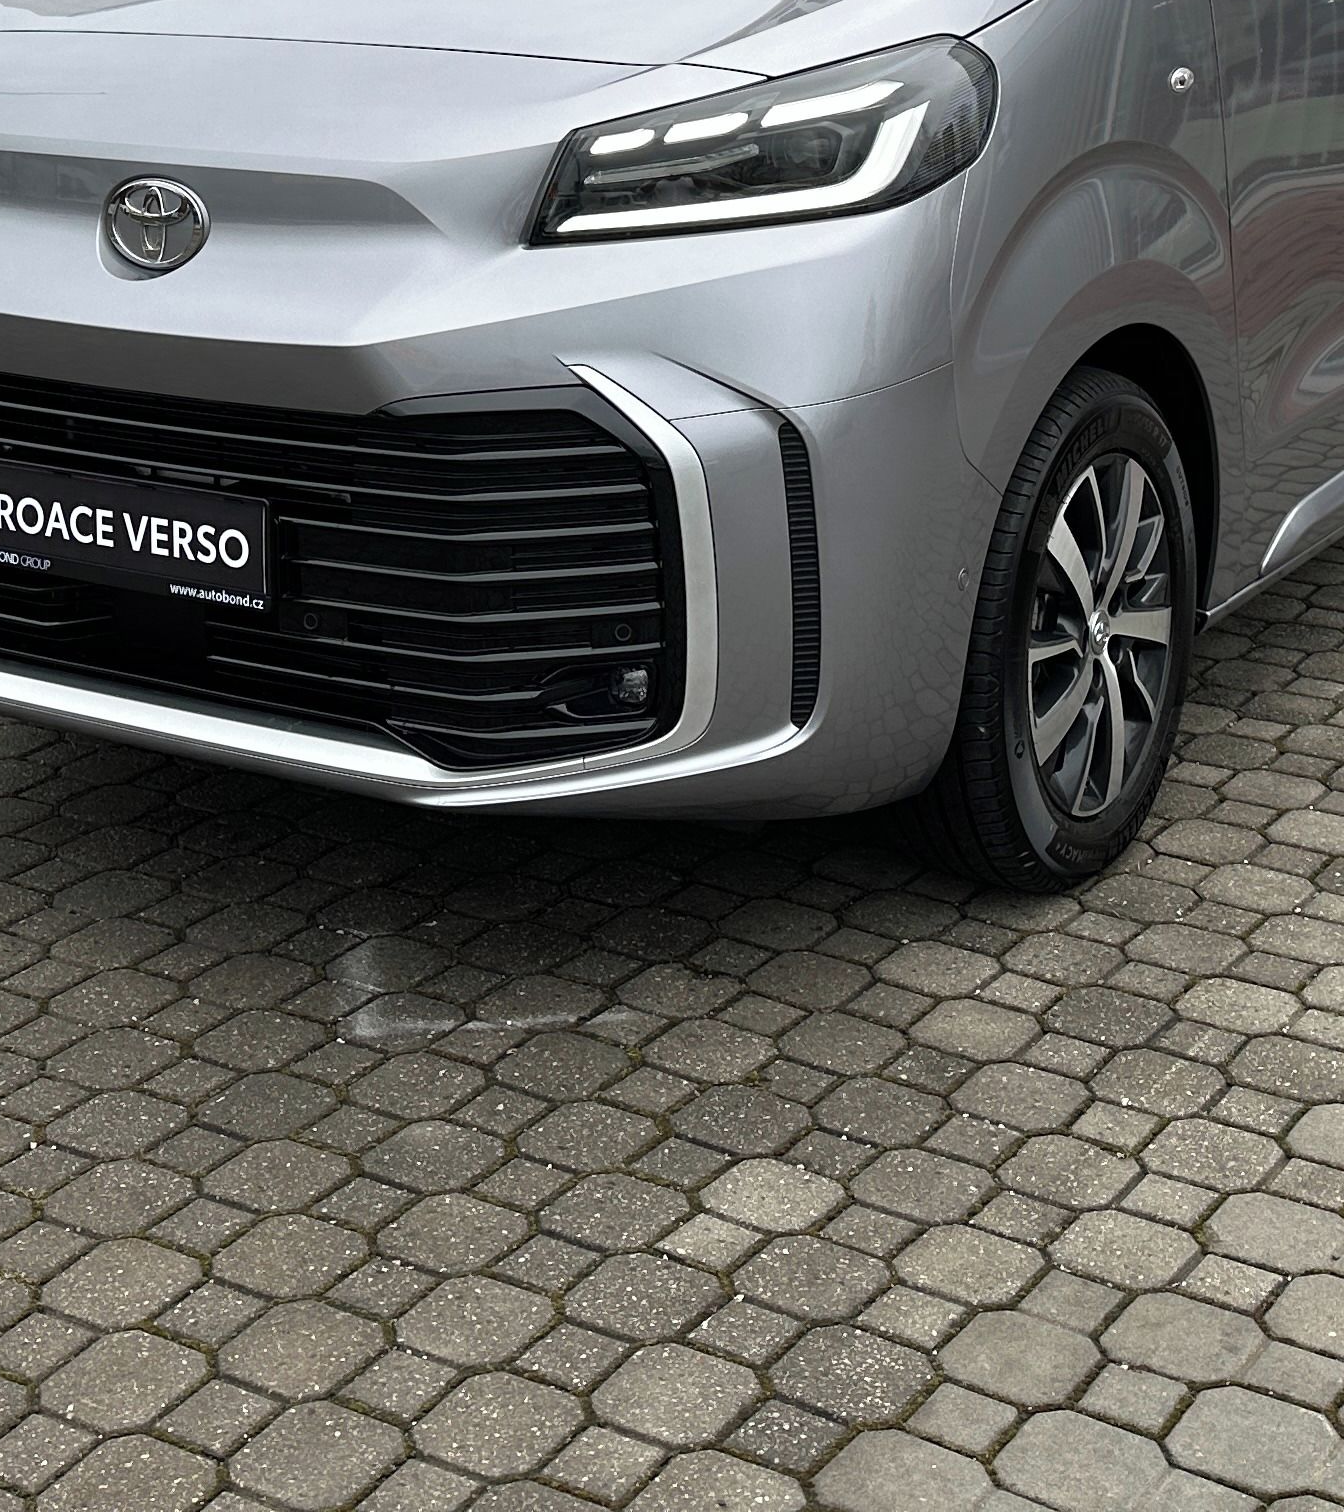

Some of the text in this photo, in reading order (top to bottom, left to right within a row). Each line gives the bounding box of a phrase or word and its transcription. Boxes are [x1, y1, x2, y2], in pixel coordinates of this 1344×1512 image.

[122, 512, 250, 569] VERSO
[20, 555, 51, 571] GROUP
[169, 583, 265, 610] www.autobond.cz
